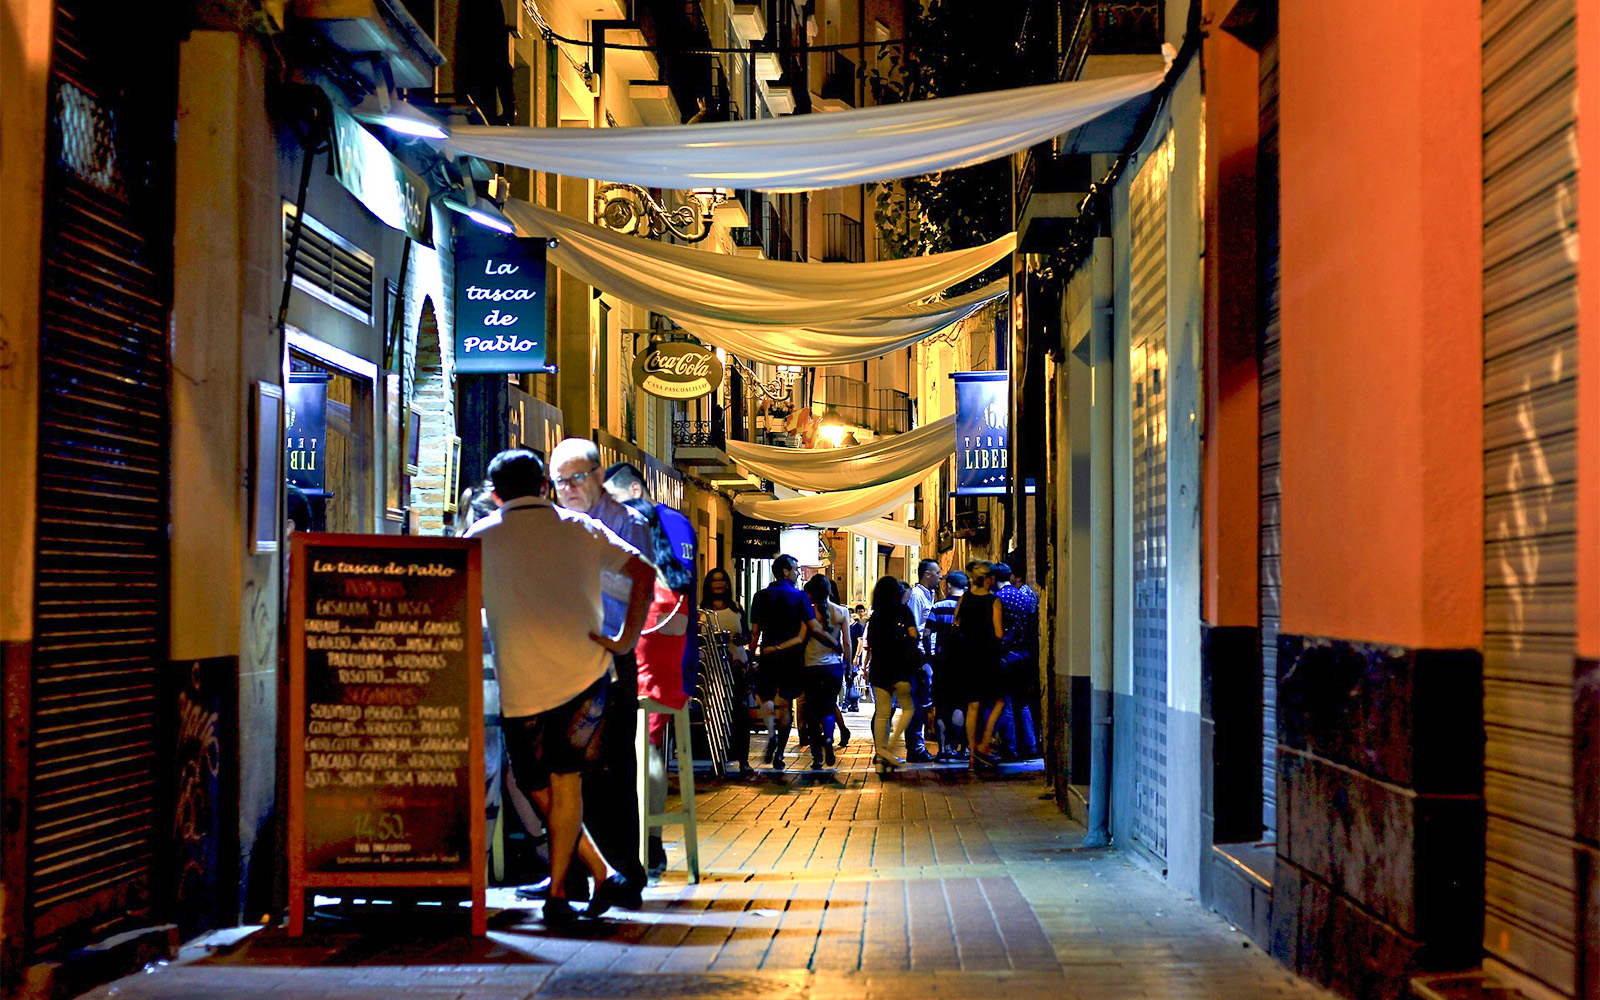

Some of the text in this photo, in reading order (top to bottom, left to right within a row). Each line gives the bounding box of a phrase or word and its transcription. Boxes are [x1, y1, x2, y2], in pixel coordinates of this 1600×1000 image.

[484, 259, 519, 275] La
[465, 284, 536, 301] tasca
[483, 309, 518, 326] de
[463, 335, 538, 352] Pablo
[313, 560, 456, 577] La tasca de Pablo
